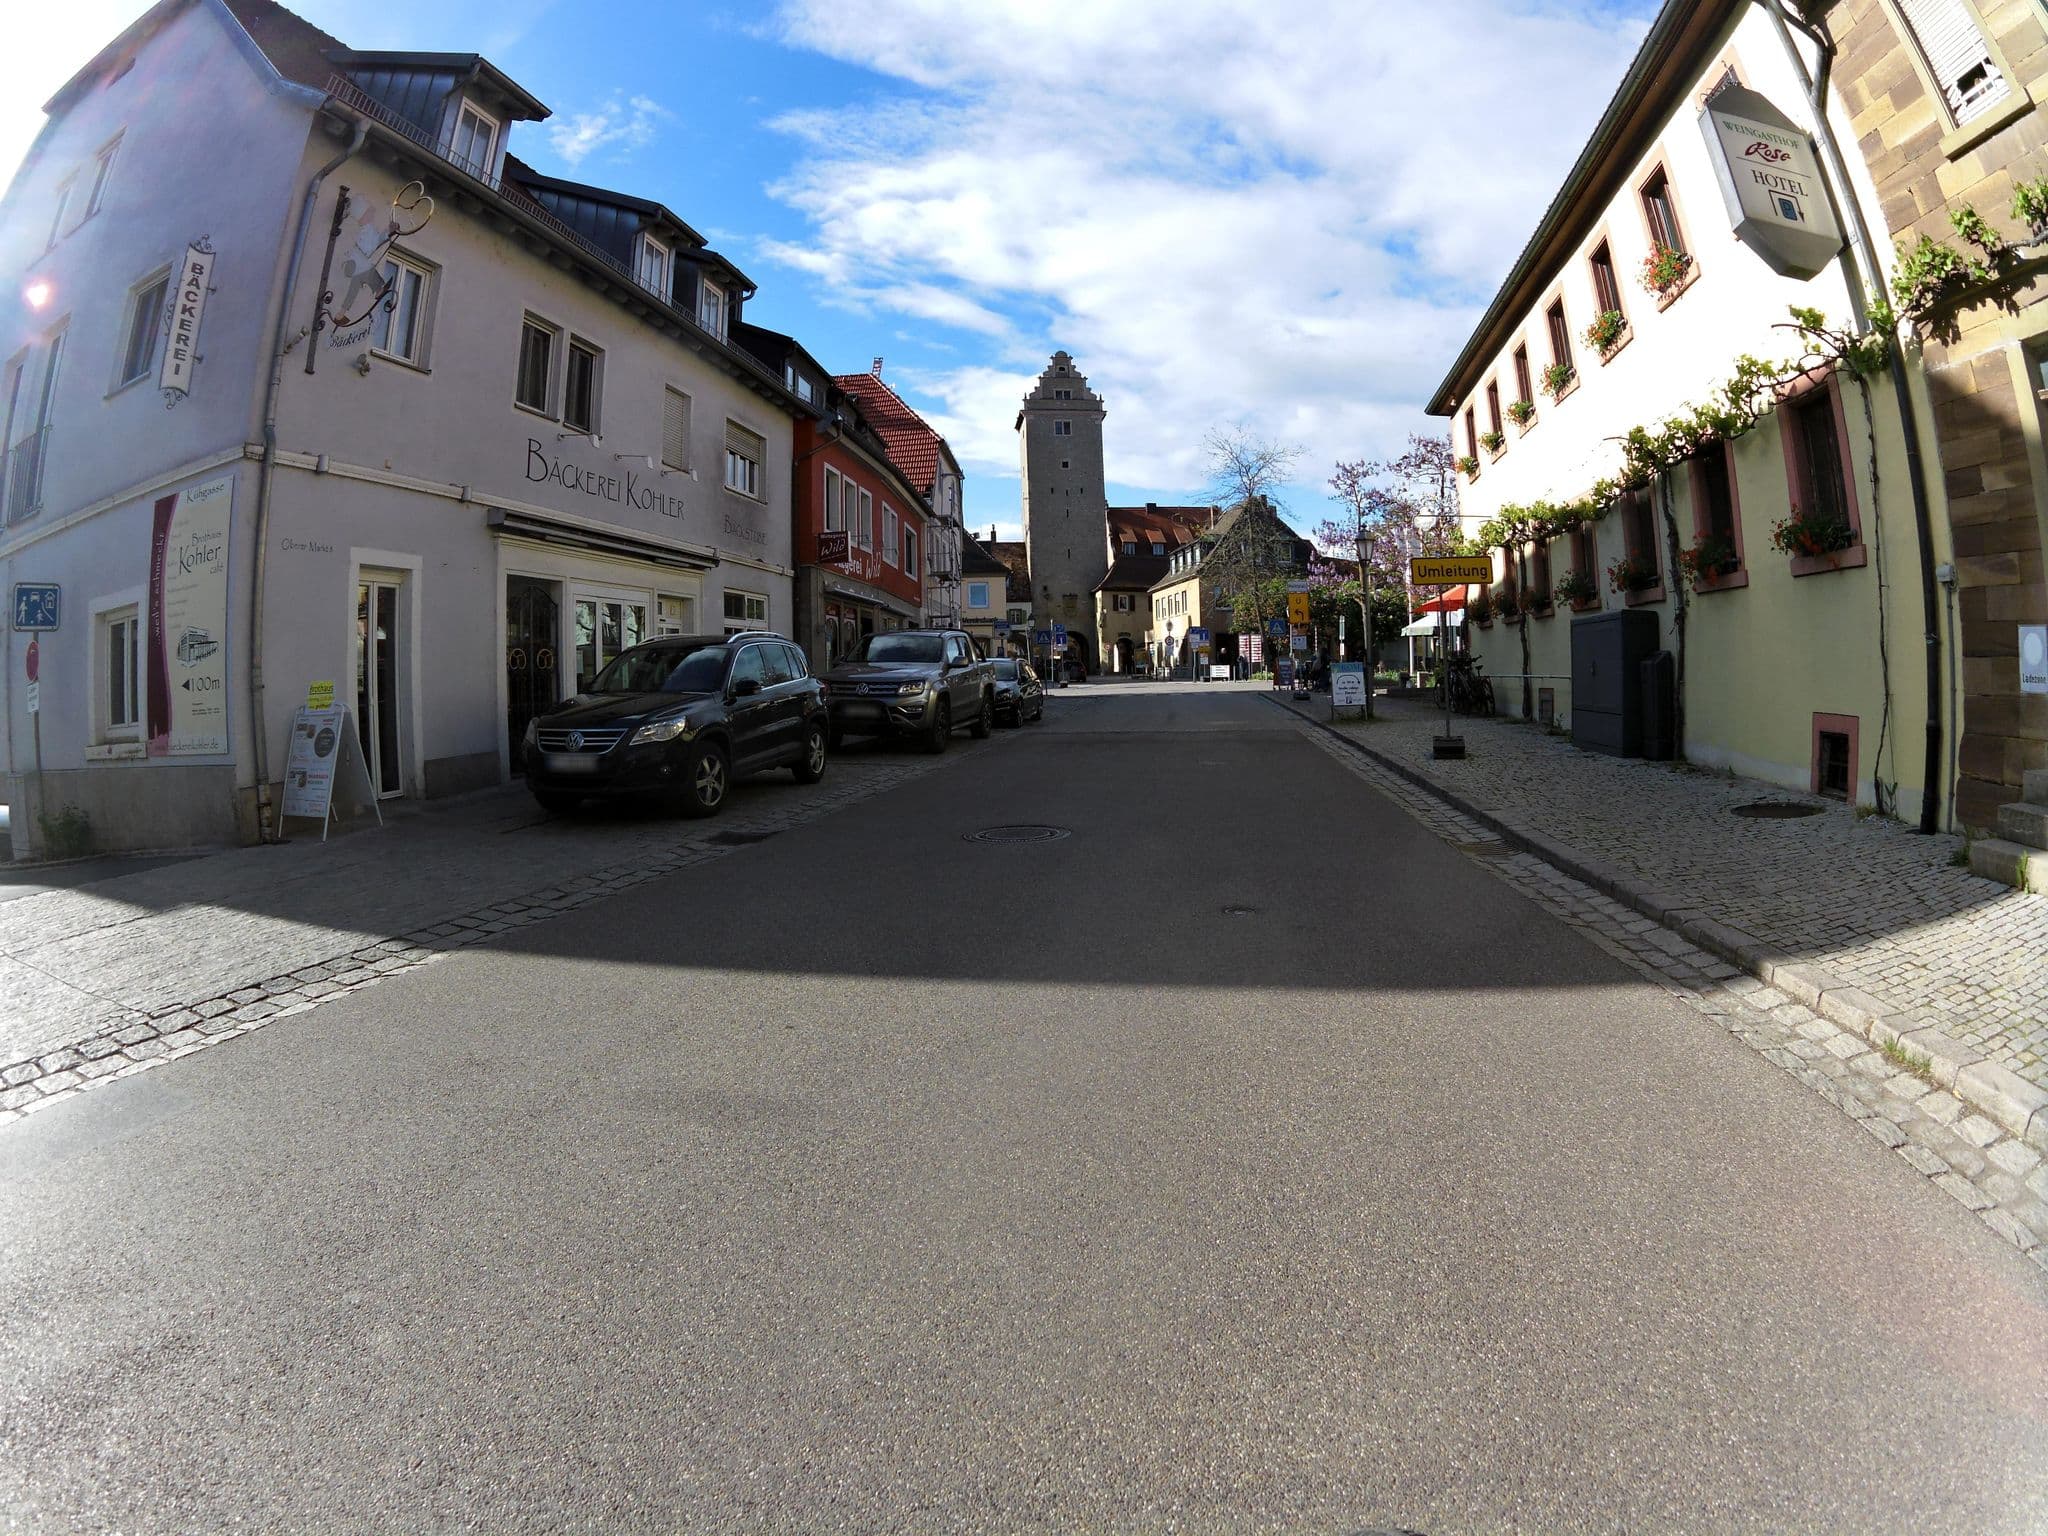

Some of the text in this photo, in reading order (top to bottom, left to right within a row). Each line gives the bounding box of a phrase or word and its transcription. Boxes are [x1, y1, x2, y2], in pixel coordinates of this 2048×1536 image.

[1722, 121, 1800, 149] WEINGASTHOF
[1745, 142, 1791, 162] Rose
[1751, 169, 1808, 197] HOTEL
[174, 262, 204, 375] BÄCKEREI
[525, 438, 685, 520] BÄCKEREI KOHLER
[179, 544, 222, 576] Kohler
[821, 538, 846, 556] Wild
[1418, 565, 1487, 580] Umleitung
